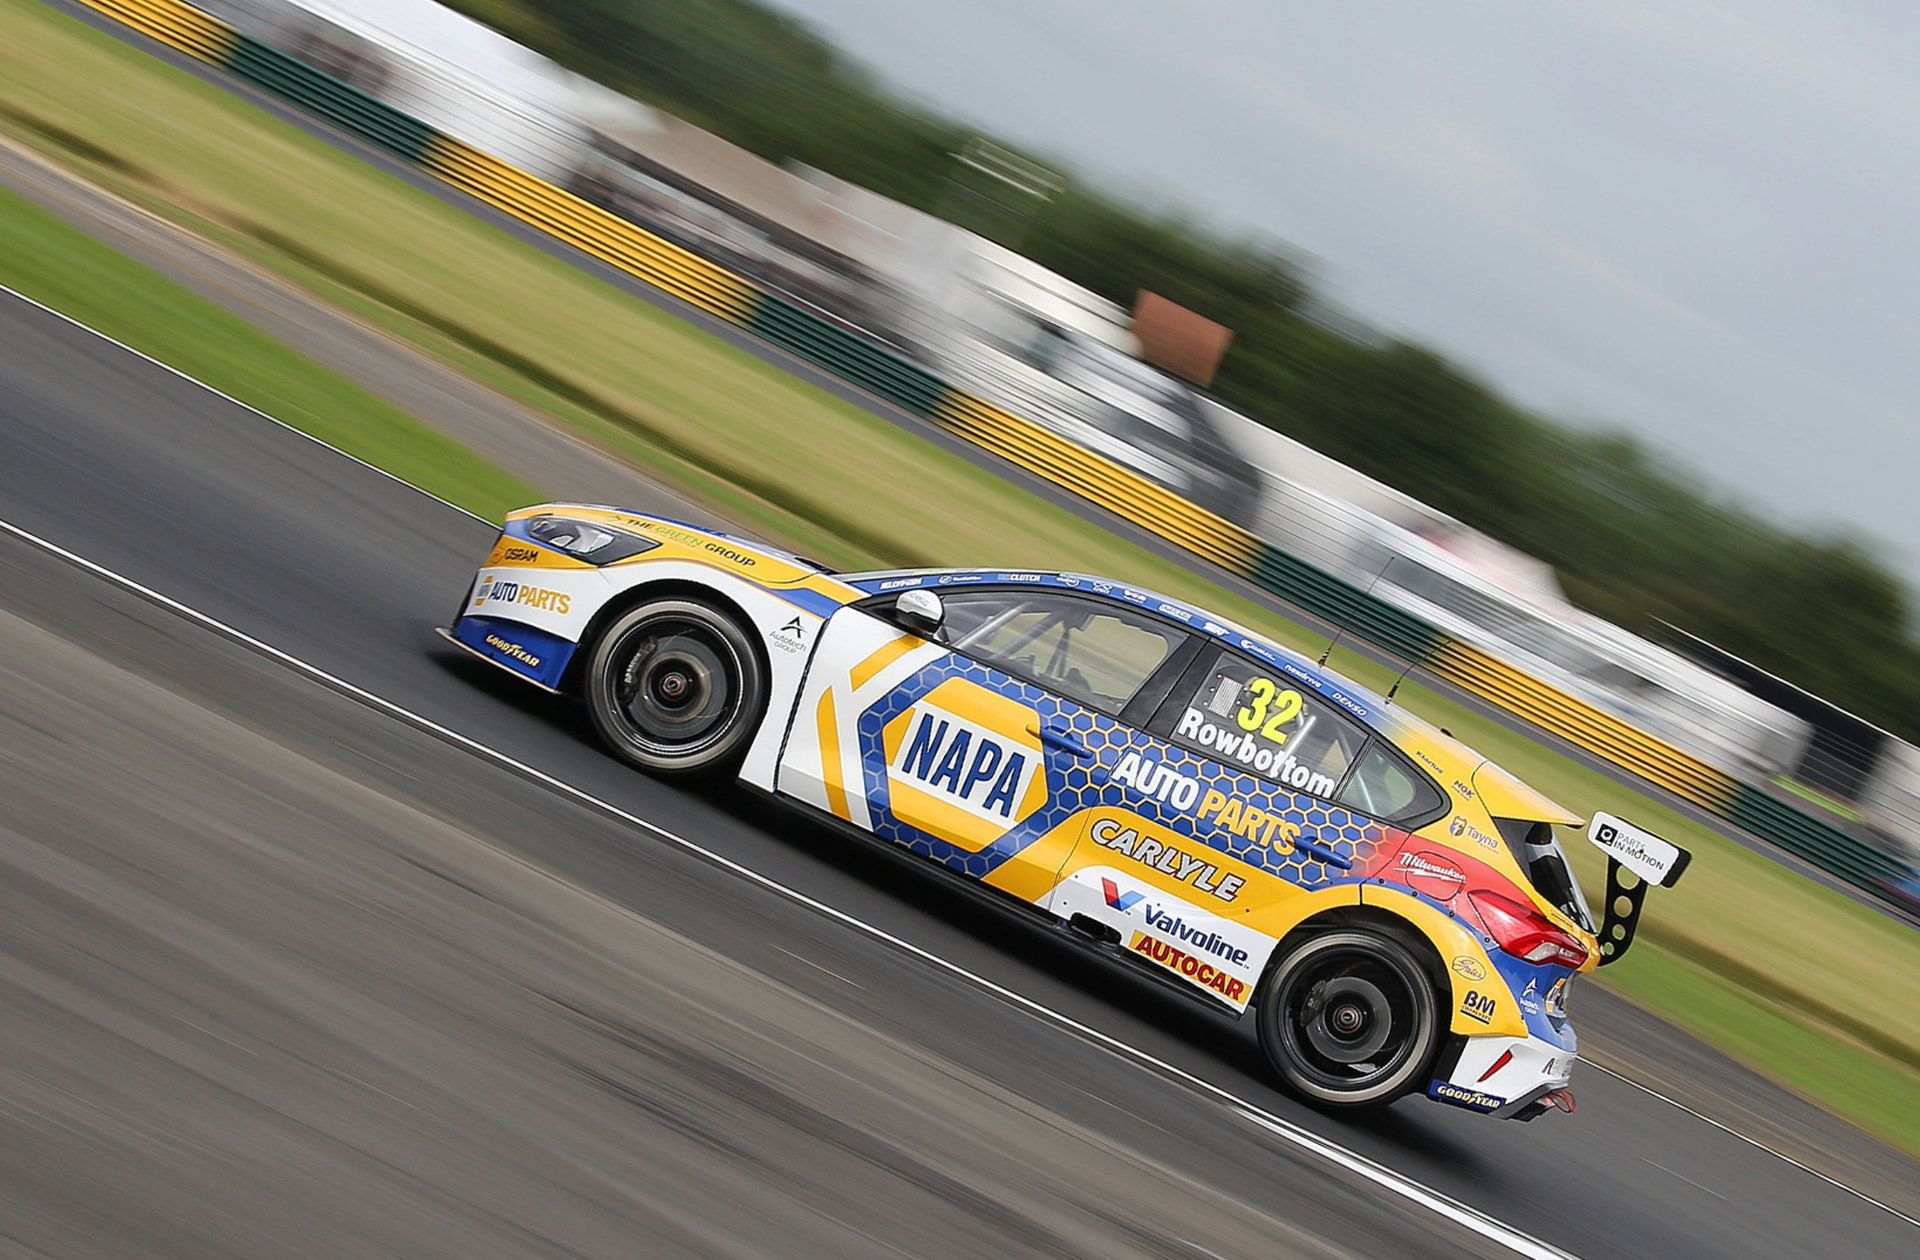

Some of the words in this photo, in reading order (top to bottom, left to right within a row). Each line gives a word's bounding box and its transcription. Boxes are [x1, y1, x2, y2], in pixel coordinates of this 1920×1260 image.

[504, 547, 539, 563] OSRAM
[656, 526, 703, 546] GREEN
[704, 542, 756, 567] GROUP
[488, 581, 519, 602] AUTO
[516, 584, 571, 615] PARTS
[486, 634, 540, 667] GOODYEAR
[1237, 678, 1303, 745] 32
[1332, 692, 1367, 716] DENSO
[901, 712, 1026, 818] NAPA
[1178, 707, 1335, 799] Rowbottom
[1110, 751, 1200, 811] AUTO
[1196, 788, 1301, 856] PARTS
[1454, 780, 1475, 798] NGK
[1467, 825, 1498, 849] Tayna
[1617, 833, 1646, 850] PARTS
[1090, 818, 1246, 902] CARLYLE
[1399, 852, 1466, 881] Milwaukee
[1613, 840, 1625, 852] IN
[1625, 847, 1665, 871] MOTION
[1145, 904, 1248, 966] Valvoline
[1135, 935, 1244, 1000] AUTOCAR
[1463, 990, 1496, 1017] BM
[1437, 1085, 1501, 1109] GOODYEAR
